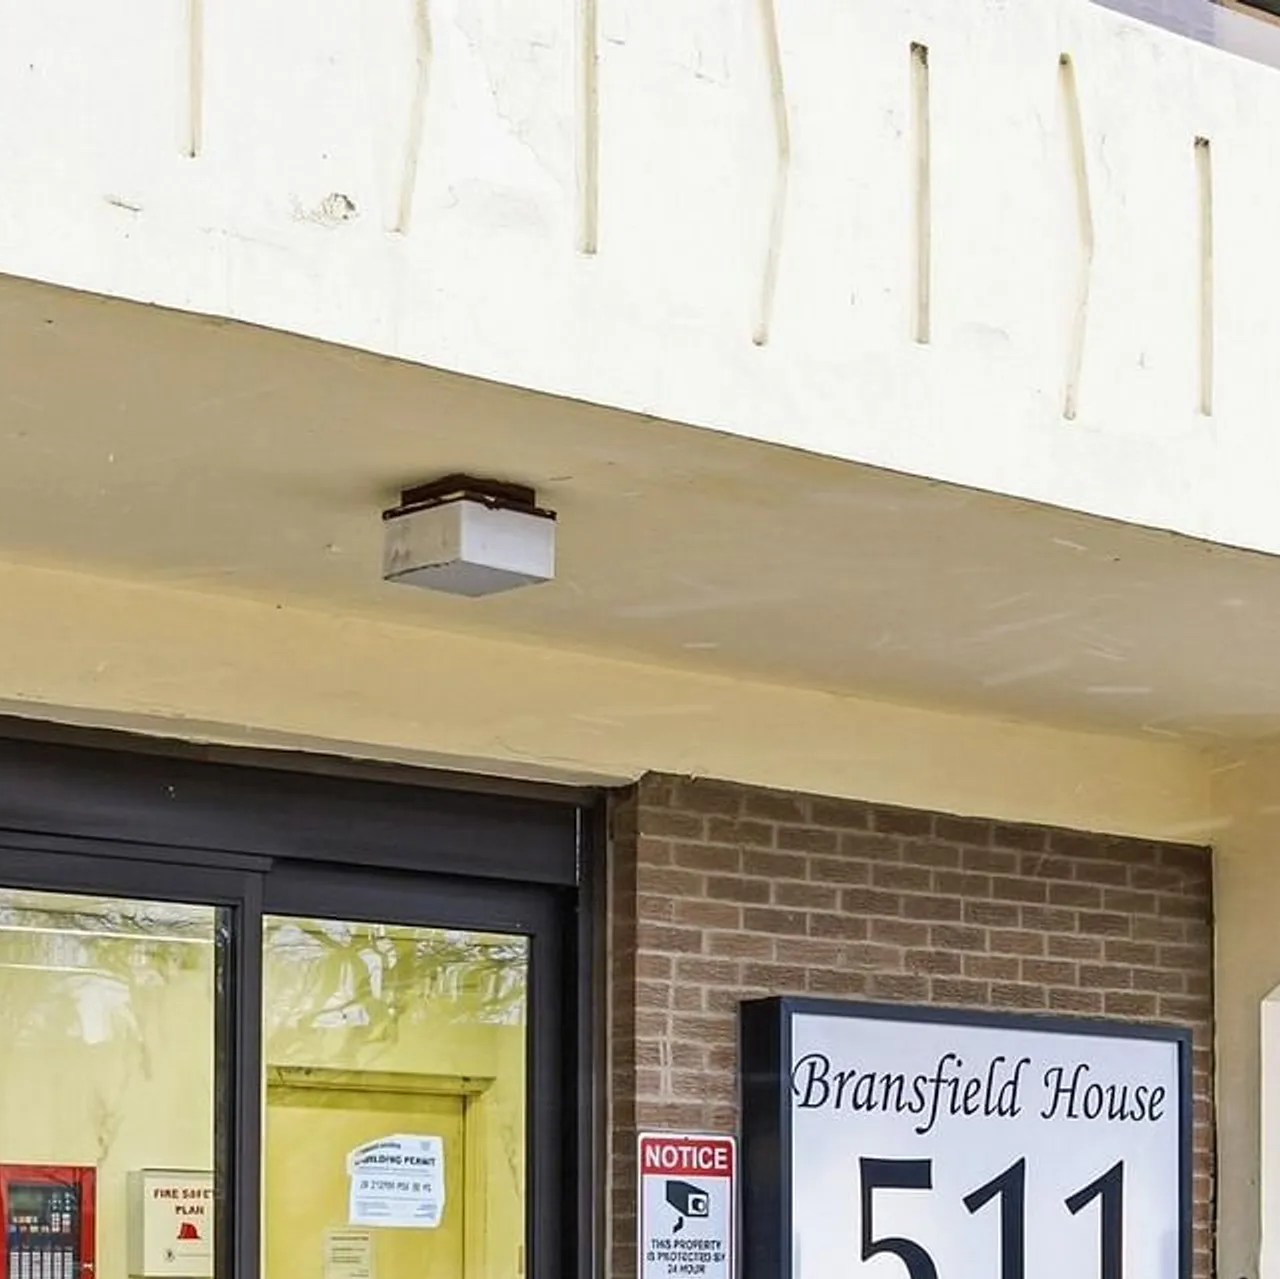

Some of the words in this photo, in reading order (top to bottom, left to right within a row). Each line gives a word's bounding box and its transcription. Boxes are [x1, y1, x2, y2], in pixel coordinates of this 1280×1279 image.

[791, 1053, 1031, 1135] Bransfield
[1040, 1063, 1166, 1121] House
[645, 1144, 729, 1170] NOTICE
[153, 1187, 179, 1199] FIRE
[175, 1205, 204, 1216] PLAN
[651, 1238, 671, 1250] THIS
[674, 1239, 722, 1251] PROPERTY
[658, 1251, 712, 1263] PROTECTED
[680, 1263, 706, 1275] HOUR
